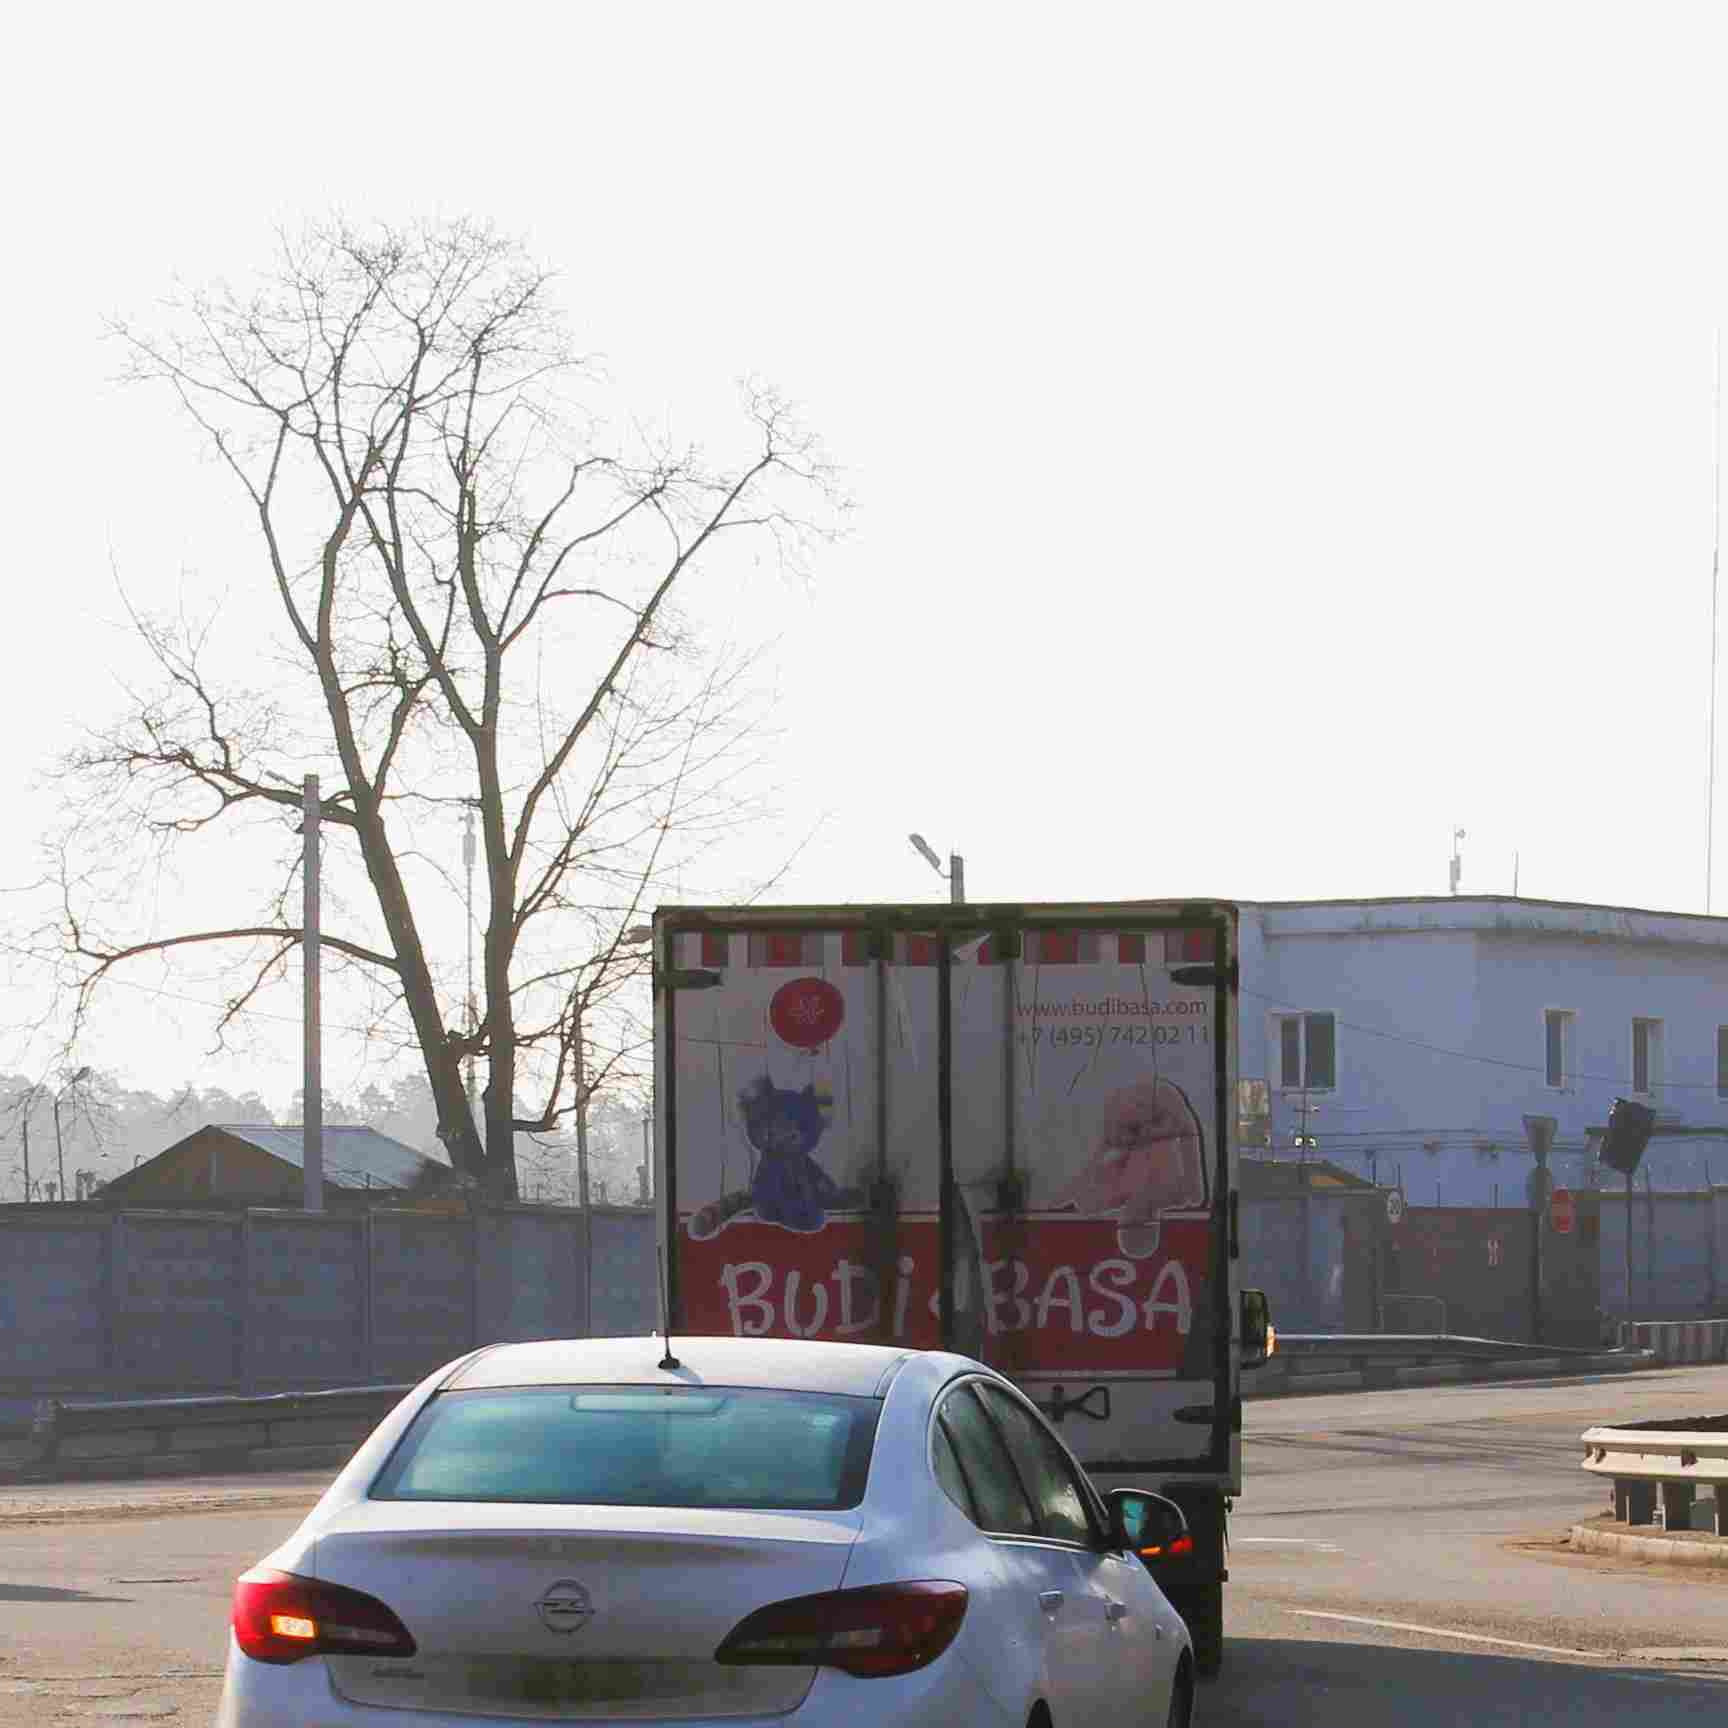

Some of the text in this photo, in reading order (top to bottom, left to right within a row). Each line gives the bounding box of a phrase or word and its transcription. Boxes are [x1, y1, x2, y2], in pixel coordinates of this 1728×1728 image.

[1016, 997, 1209, 1017] www.budibasa.com
[1049, 1023, 1104, 1049] (495)
[1111, 1025, 1148, 1045] 742
[1154, 1025, 1180, 1045] 02
[980, 1257, 1193, 1338] BASA
